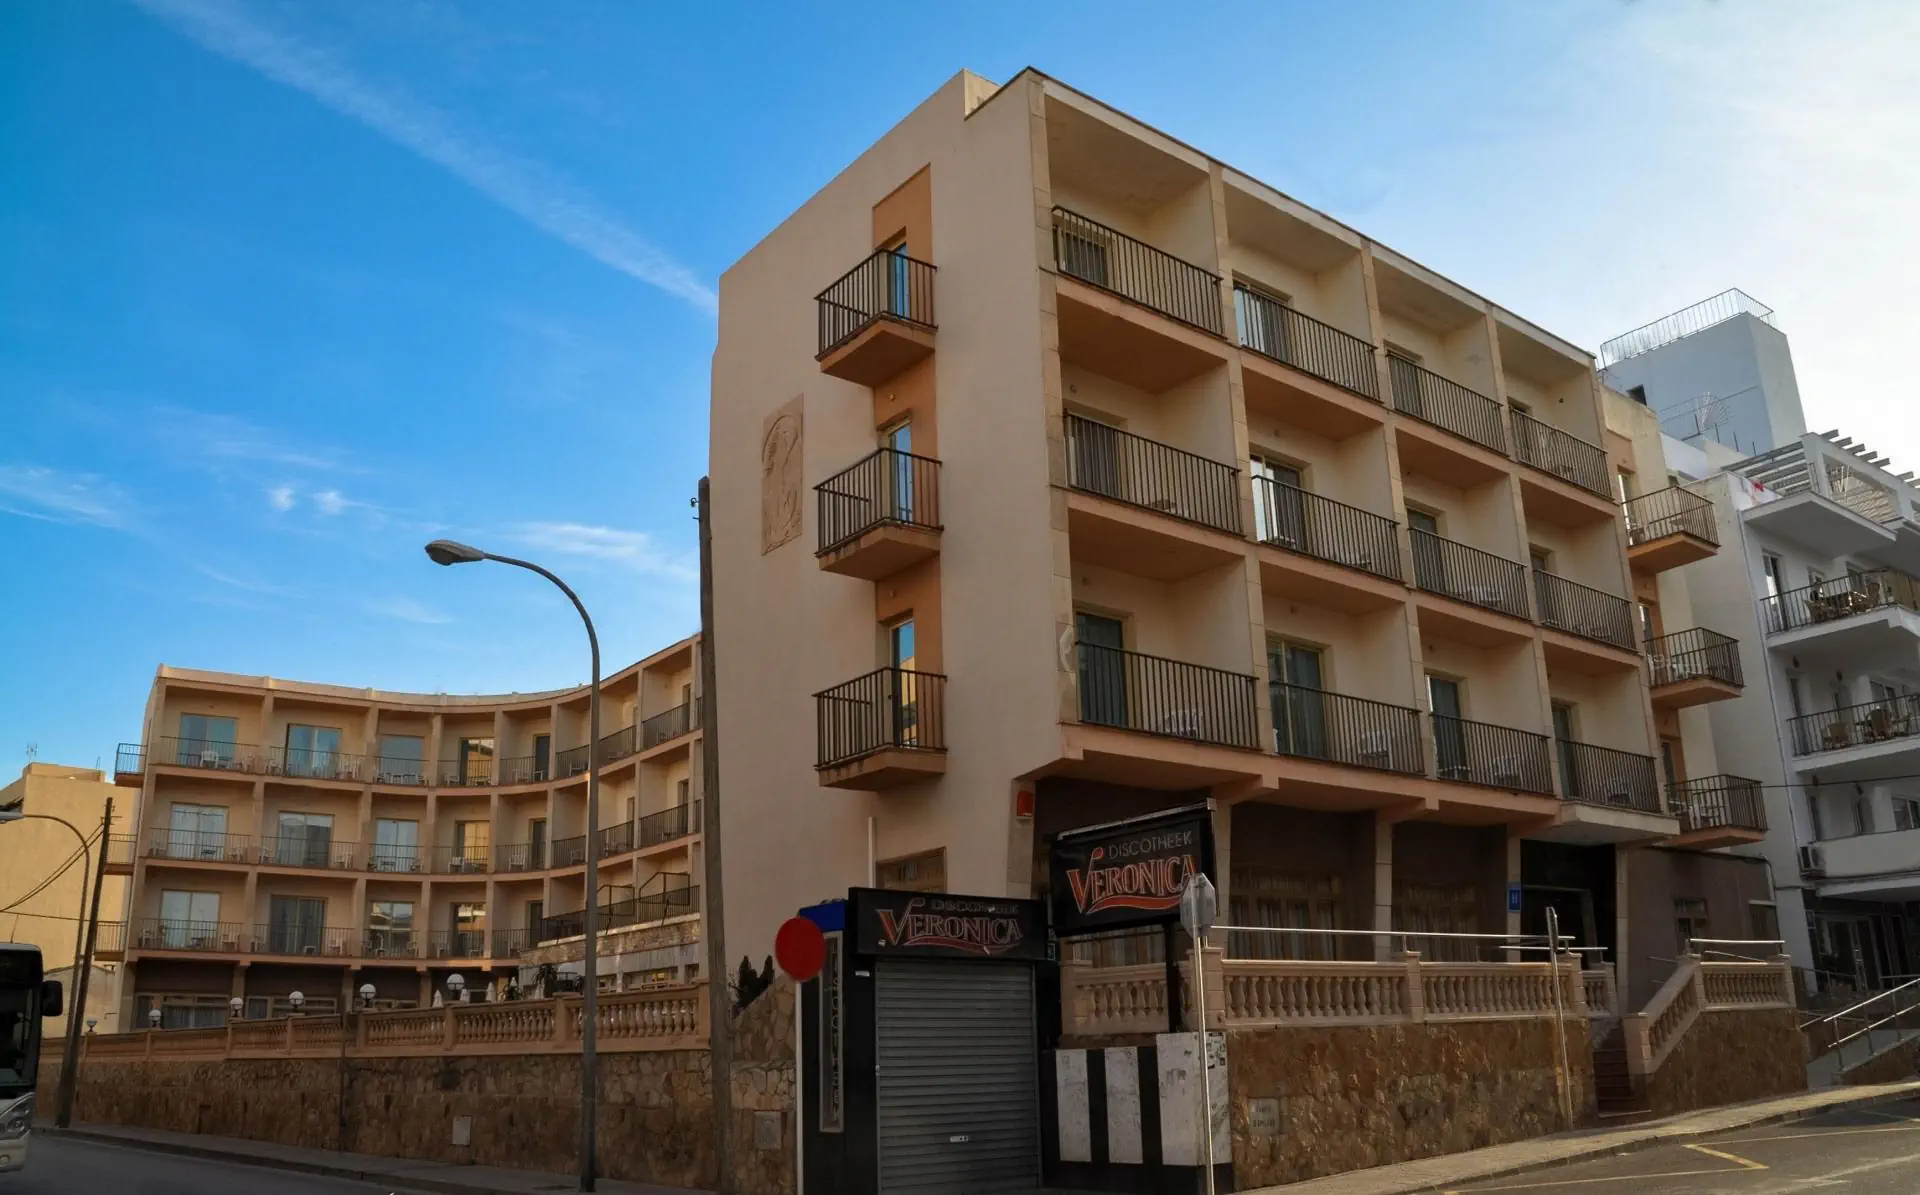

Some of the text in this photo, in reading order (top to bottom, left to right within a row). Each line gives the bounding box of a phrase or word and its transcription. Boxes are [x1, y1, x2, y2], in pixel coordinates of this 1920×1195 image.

[1107, 830, 1193, 860] DISCOTHEEK
[1065, 846, 1197, 914] VERONICA
[875, 897, 1024, 946] VERONICA
[930, 898, 1020, 915] DISCO
